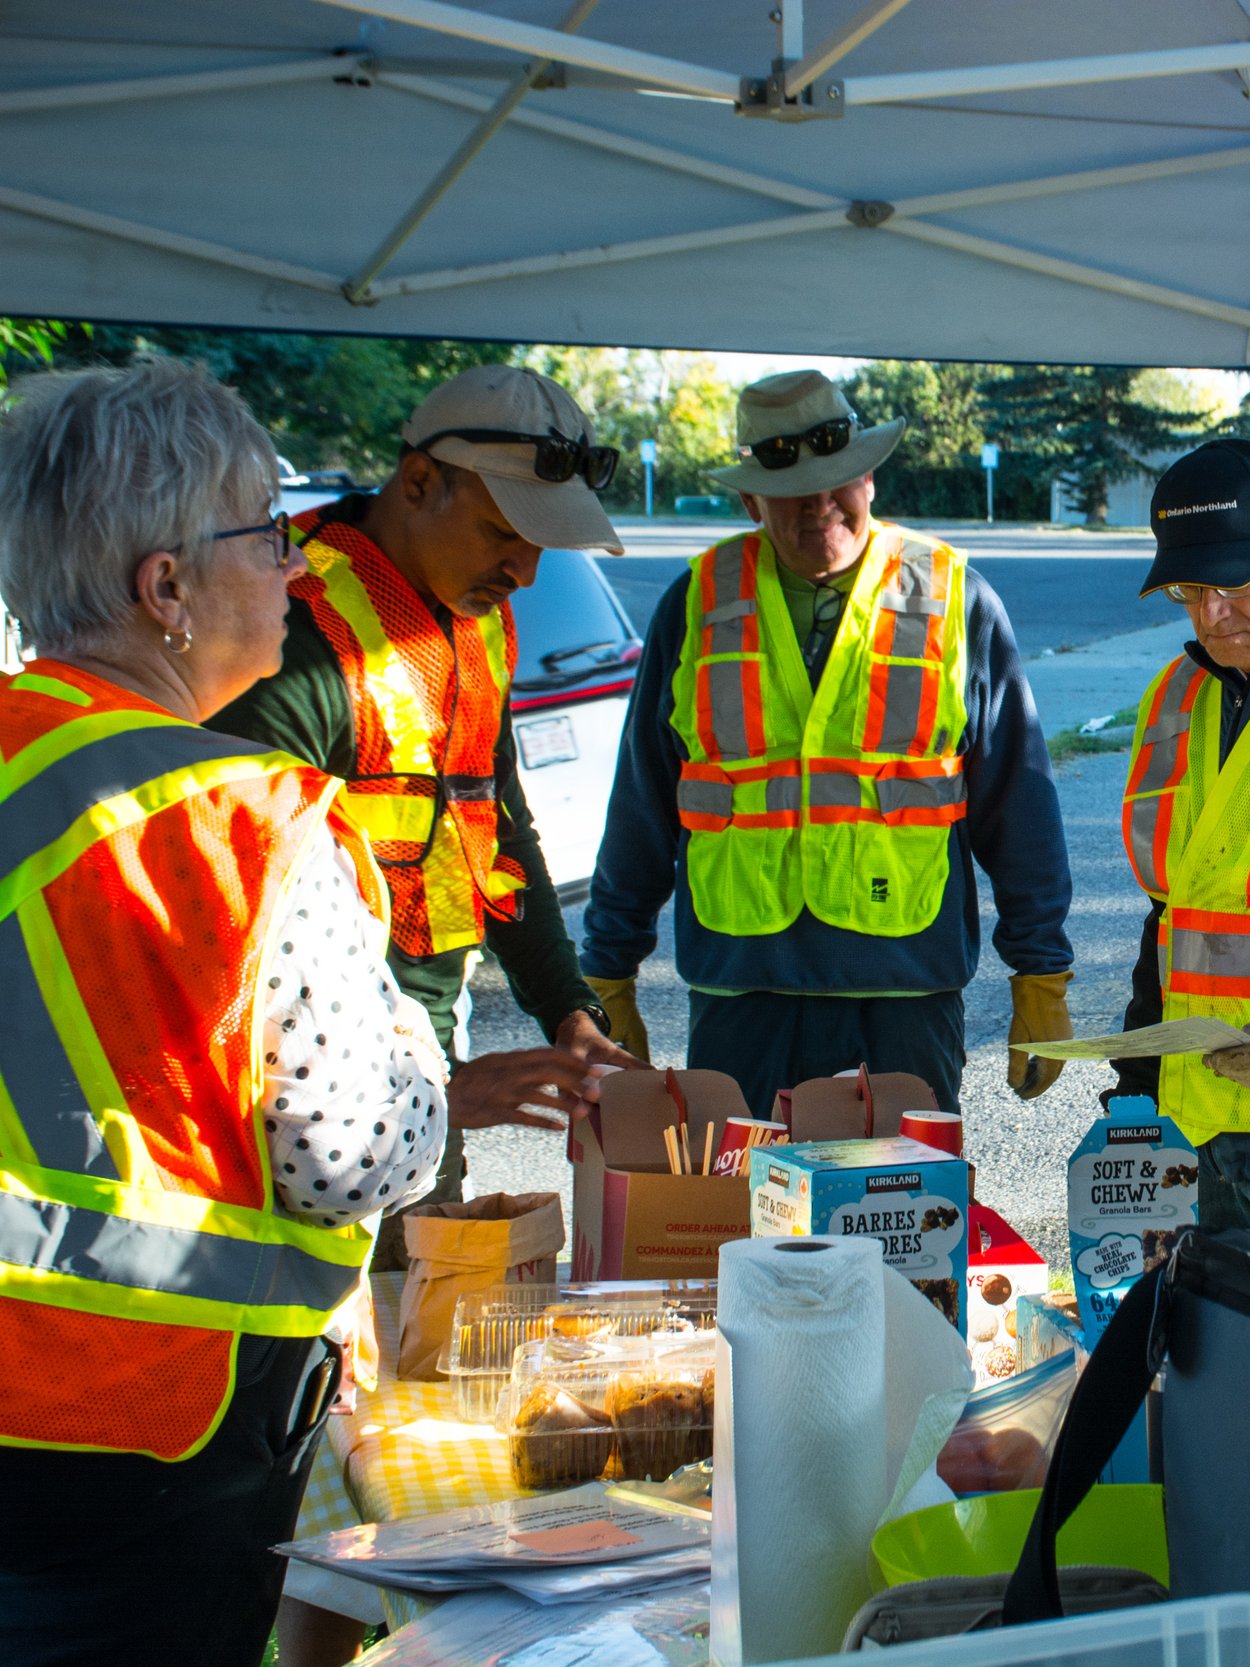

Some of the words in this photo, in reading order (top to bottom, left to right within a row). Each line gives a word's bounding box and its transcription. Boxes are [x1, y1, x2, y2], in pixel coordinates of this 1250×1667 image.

[1166, 505, 1192, 518] Ontario
[1192, 499, 1238, 514] Northland
[1109, 1127, 1160, 1139] KIRKLAND
[1093, 1160, 1135, 1181] SOFT
[1140, 1160, 1158, 1179] &
[868, 1174, 920, 1187] KIRKLAND
[1091, 1182, 1159, 1205] CHEWY
[1099, 1205, 1131, 1216] Granola
[1133, 1204, 1152, 1214] Bars
[665, 1223, 700, 1233] ORDER
[702, 1224, 738, 1234] AHEAD
[739, 1224, 750, 1234] AT
[842, 1209, 916, 1235] BARRES
[636, 1245, 703, 1256] COMMANDEZ
[877, 1232, 922, 1256] DRES
[1109, 1240, 1122, 1251] WITH
[882, 1256, 907, 1265] ranola
[1094, 1251, 1137, 1275] CHOCOLATE
[1101, 1249, 1122, 1263] REAL
[1107, 1263, 1130, 1278] CHIPS
[1090, 1291, 1117, 1313] 64
[1096, 1313, 1114, 1323] BAR
